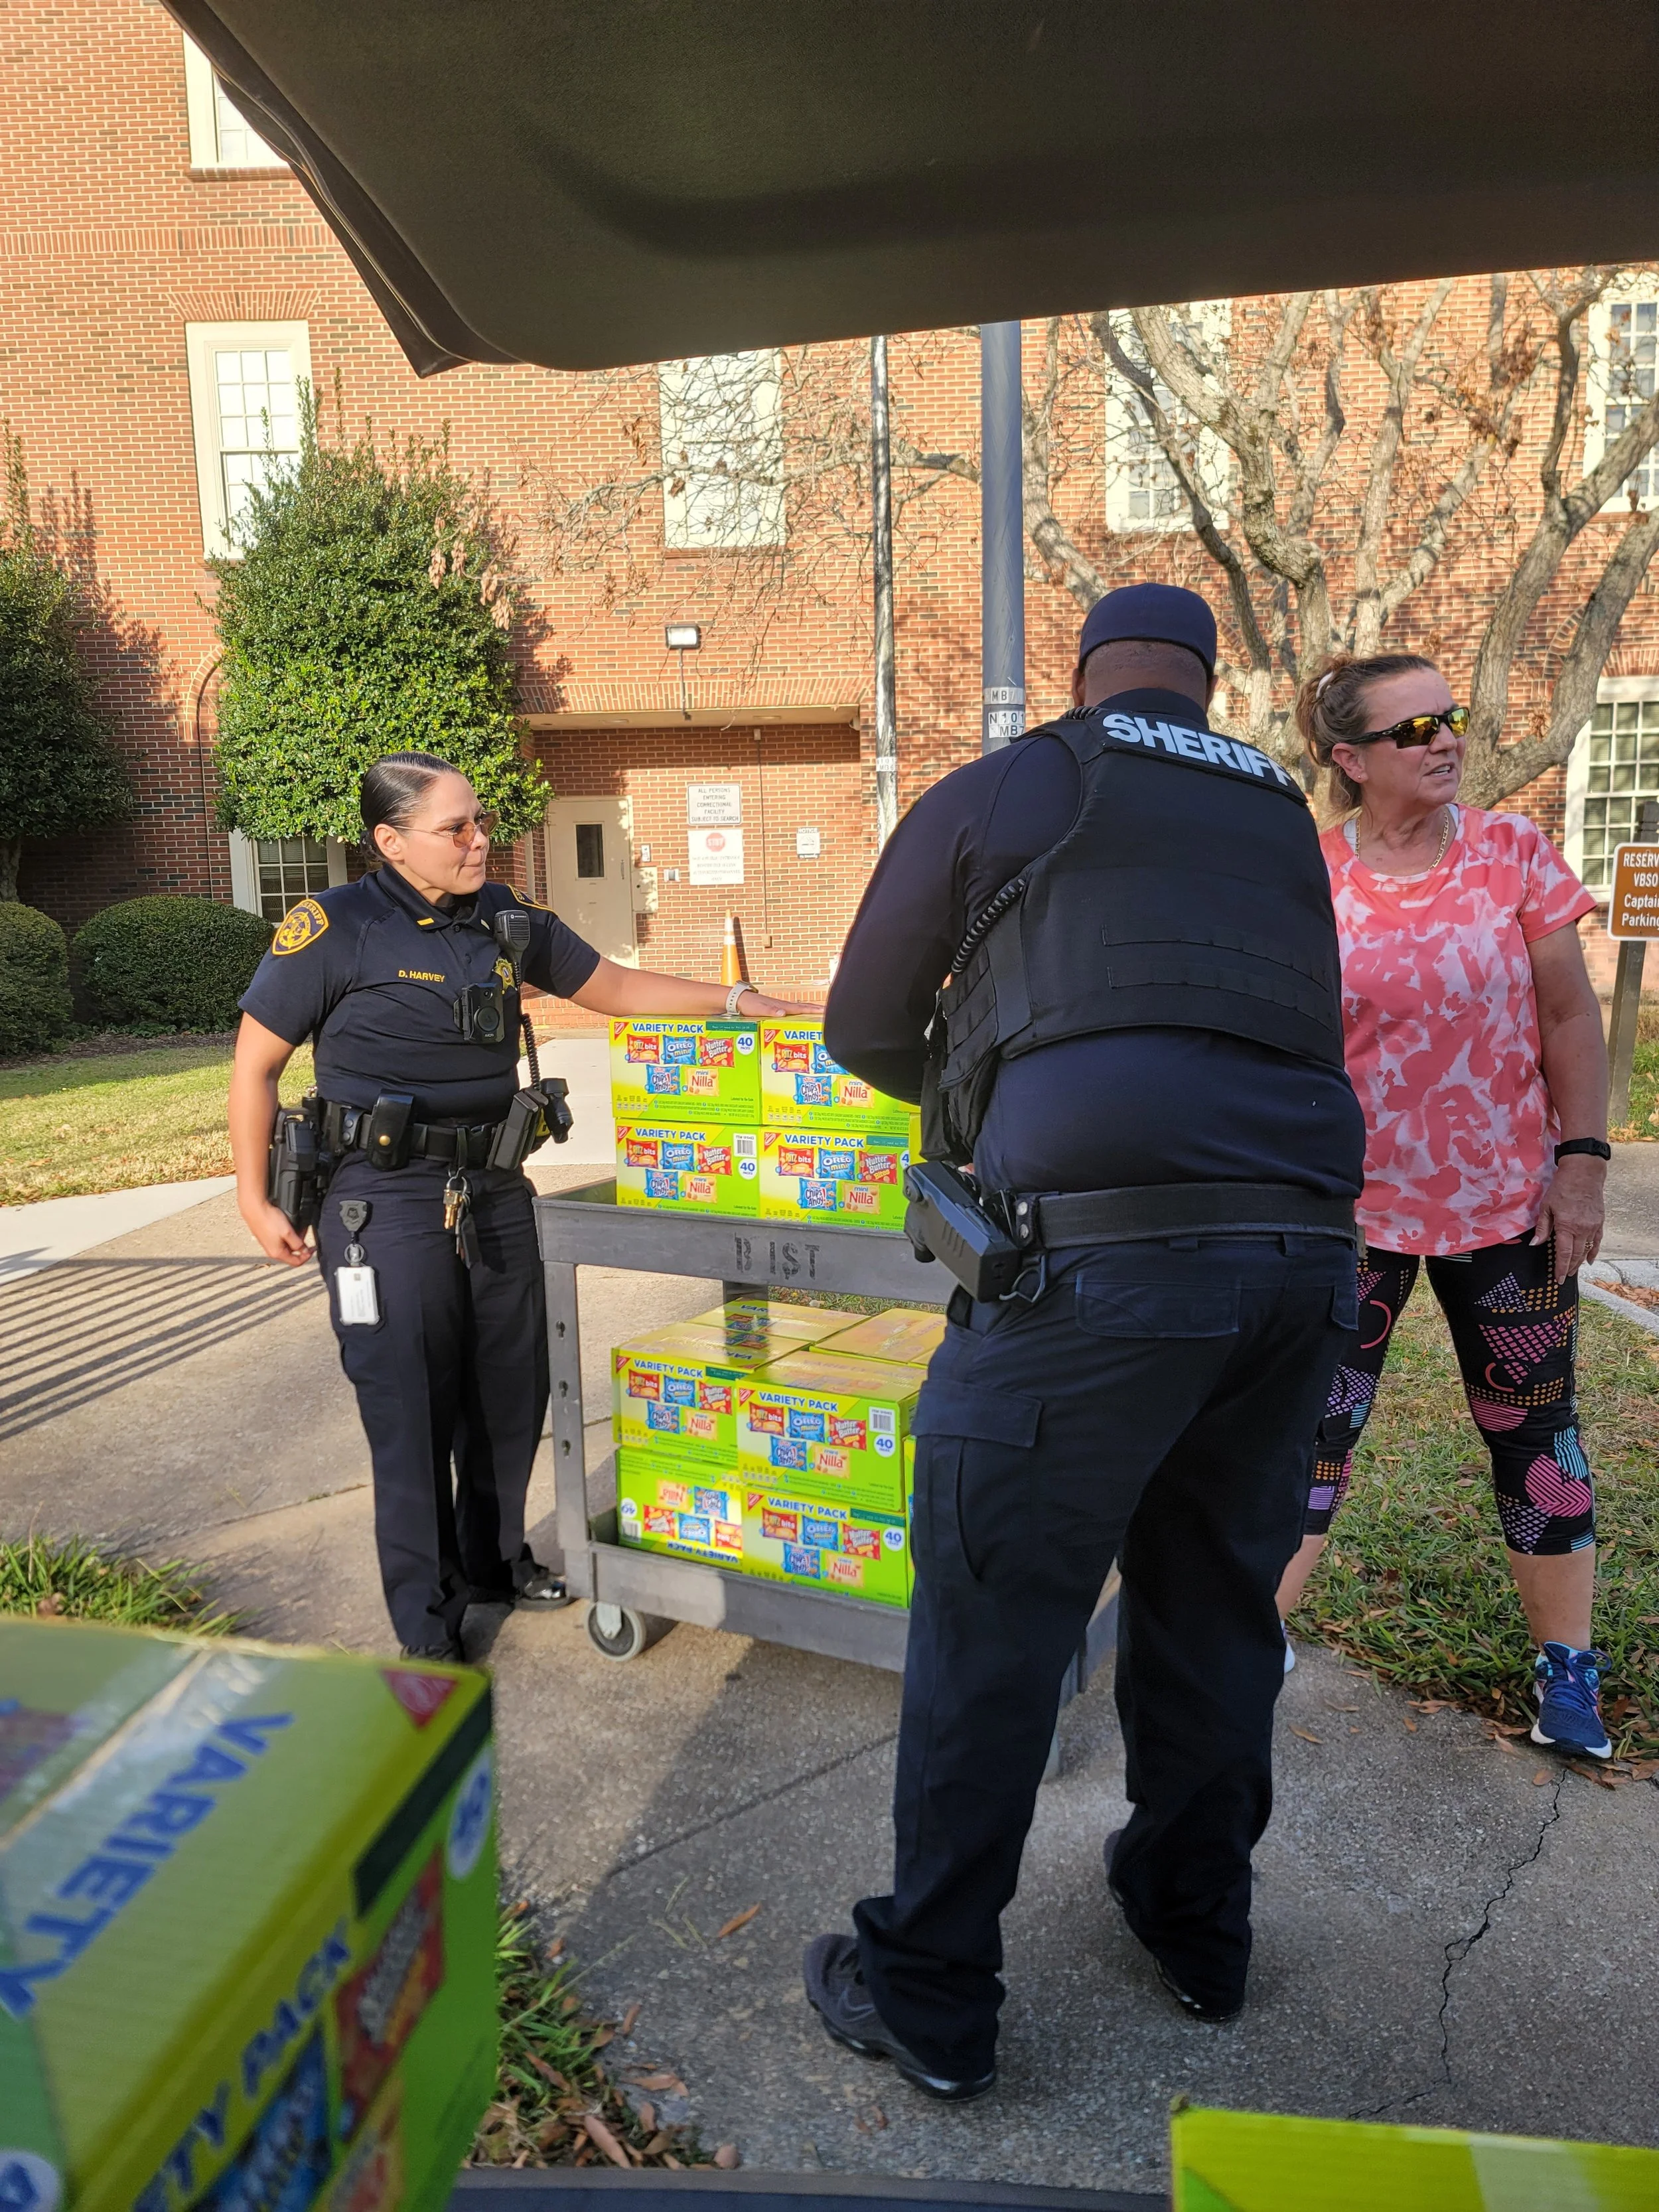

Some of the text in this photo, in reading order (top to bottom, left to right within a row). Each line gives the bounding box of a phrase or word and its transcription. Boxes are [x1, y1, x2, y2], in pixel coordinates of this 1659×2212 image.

[1102, 713, 1292, 786] SHERIFF
[1623, 851, 1659, 867] RESERV
[1634, 872, 1658, 887] VBSO
[398, 970, 445, 983] D. HARVEY
[632, 1023, 703, 1033] VARIETY PACK
[784, 1031, 822, 1040] VARIET
[644, 1042, 657, 1051] bits
[667, 1043, 693, 1051] OREO
[705, 1040, 725, 1051] Nutter
[738, 1037, 753, 1047] 40
[708, 1046, 729, 1058] Butter
[793, 1051, 806, 1059] bits
[691, 1075, 713, 1088] Nilla
[844, 1086, 868, 1098] Nilla
[636, 1128, 706, 1141] VARIETY PACK
[785, 1134, 831, 1145] VARIETY
[835, 1138, 864, 1147] PACK
[644, 1147, 656, 1155] bits
[666, 1149, 691, 1157] OREO
[703, 1147, 723, 1158] Nutter
[707, 1154, 725, 1165] Butter
[798, 1155, 812, 1163] bits
[823, 1157, 851, 1166] OREO
[865, 1155, 888, 1167] Nutter
[740, 1162, 755, 1171] 40
[869, 1161, 891, 1174] Butter
[689, 1182, 711, 1194] Nilla
[849, 1191, 873, 1205] Nilla
[634, 1359, 674, 1372] VARIETY
[678, 1366, 703, 1378] PACK
[759, 1392, 838, 1412] VARIETY PACK
[691, 1418, 712, 1431] Nilla
[876, 1438, 893, 1449] 40
[819, 1454, 843, 1468] Nilla
[768, 1497, 814, 1513] VARIETY
[818, 1507, 848, 1520] PACK
[885, 1531, 902, 1543] 40
[833, 1562, 857, 1578] Nilla
[0, 1713, 294, 2015] VARIETY
